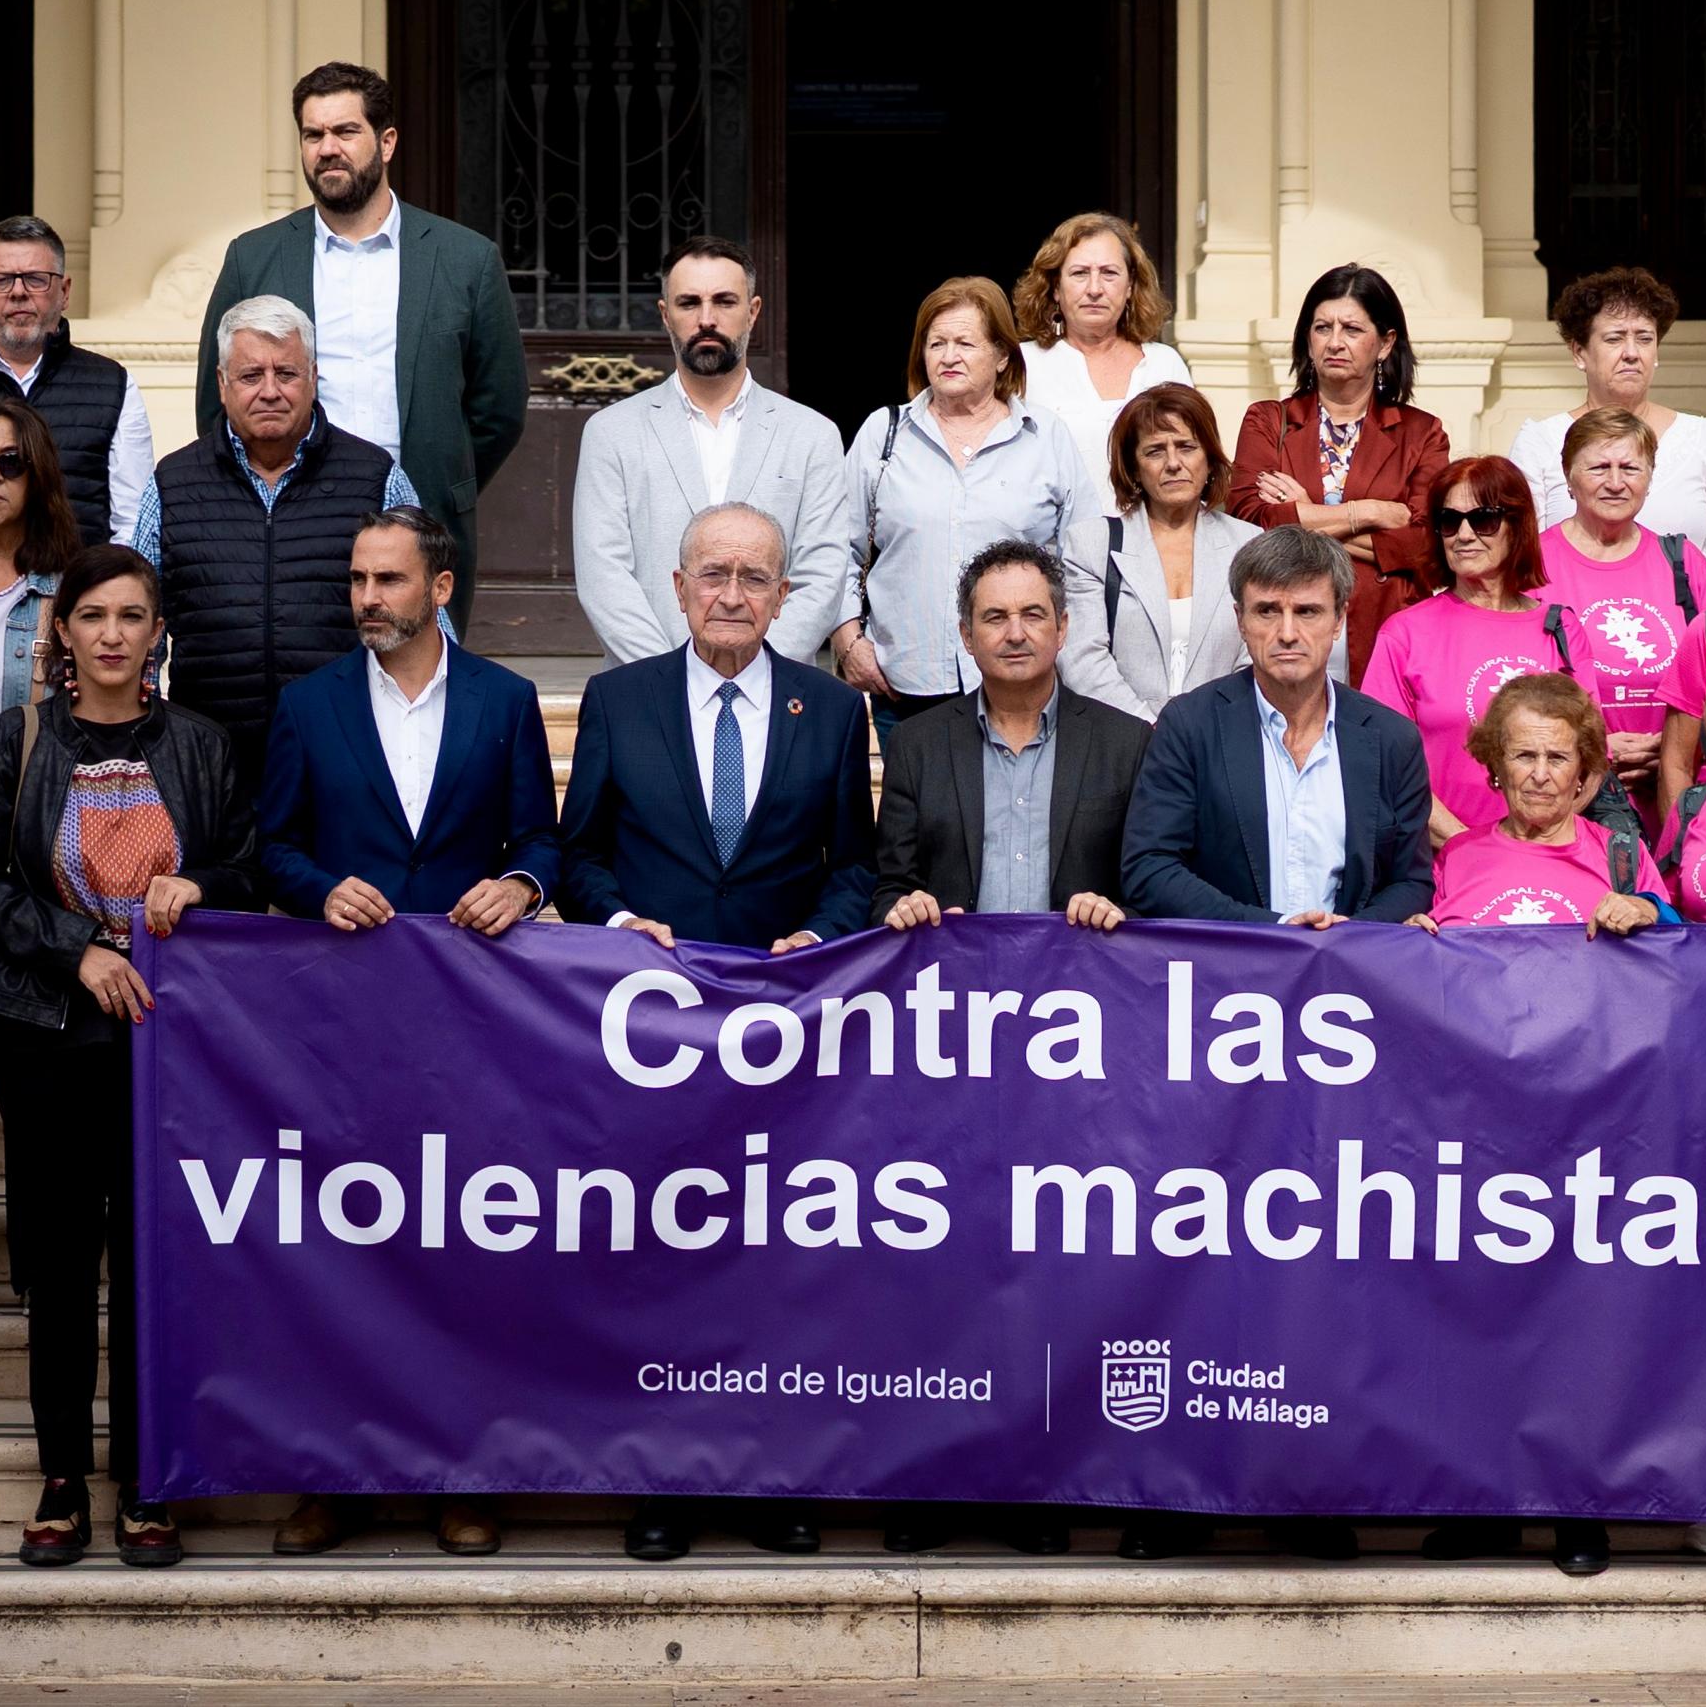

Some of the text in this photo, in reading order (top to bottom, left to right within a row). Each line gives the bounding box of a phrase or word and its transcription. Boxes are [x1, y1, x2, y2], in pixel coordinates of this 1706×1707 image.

[1473, 886, 1537, 921] CULTURAL
[599, 961, 1376, 1088] Contra las
[179, 1129, 950, 1252] violencias
[638, 1362, 991, 1403] Ciudad de Igualdad
[1187, 1360, 1285, 1389] Ciudad
[1186, 1394, 1328, 1428] de Málaga
